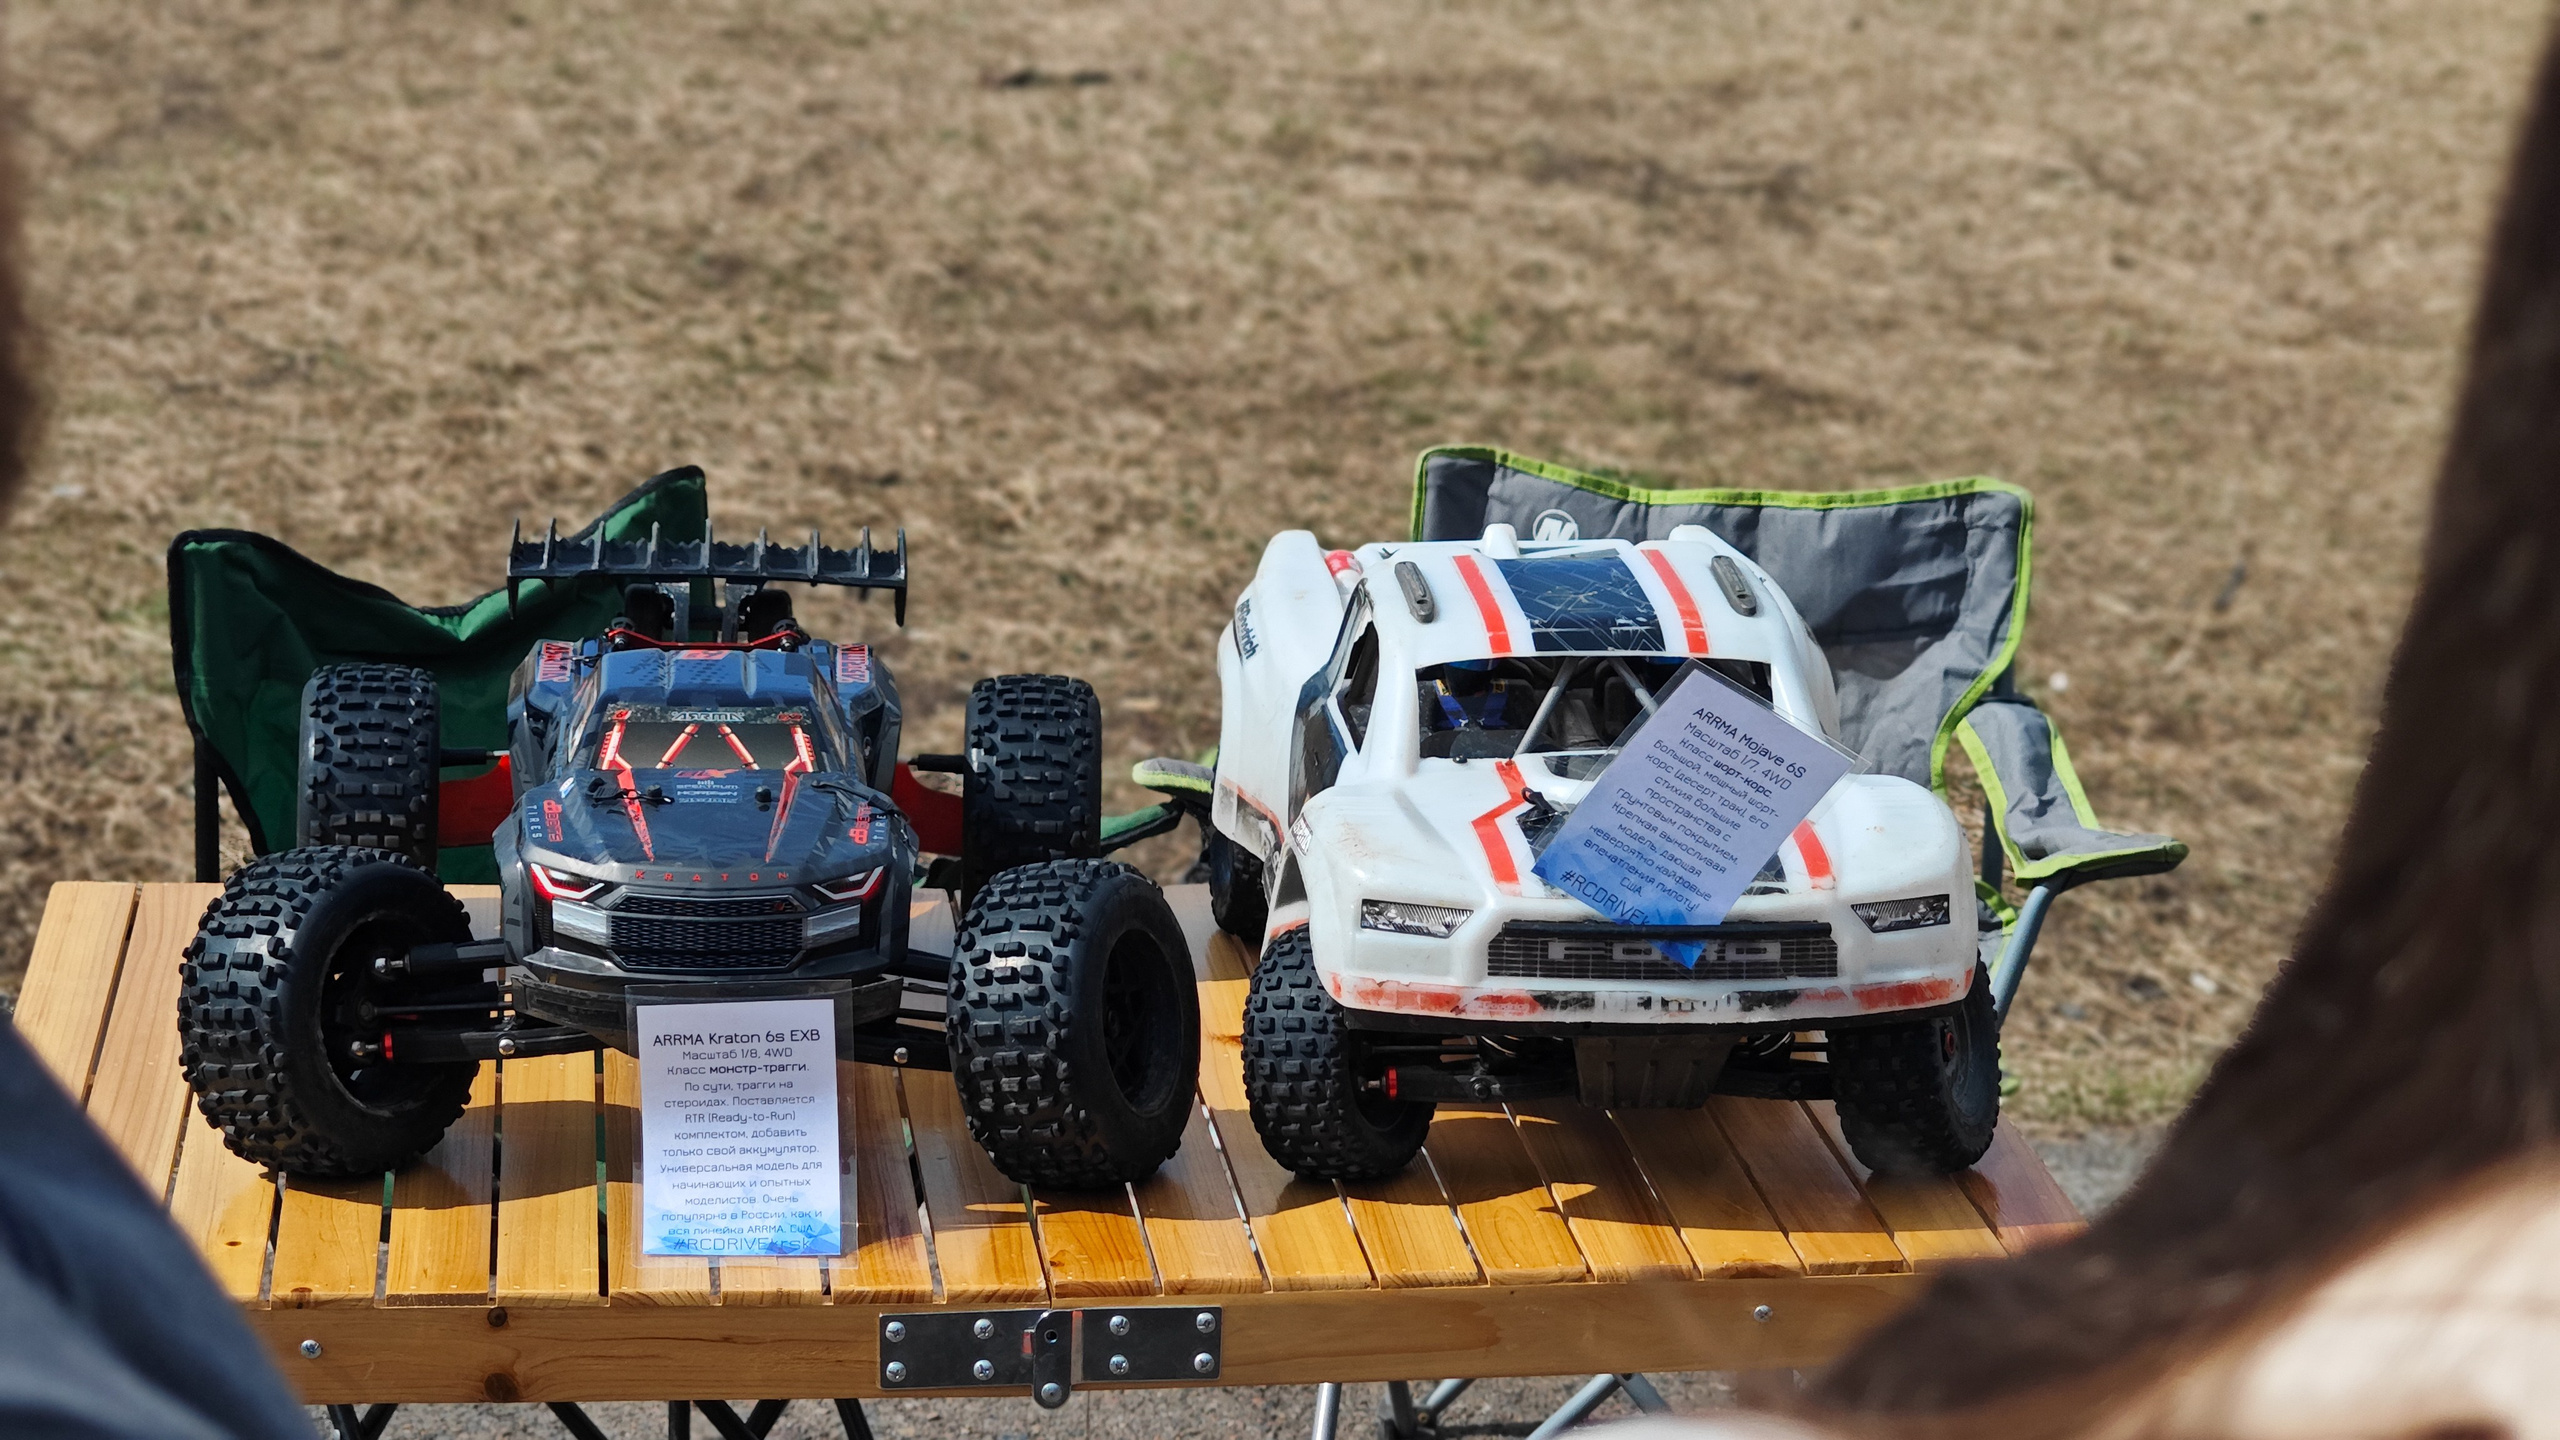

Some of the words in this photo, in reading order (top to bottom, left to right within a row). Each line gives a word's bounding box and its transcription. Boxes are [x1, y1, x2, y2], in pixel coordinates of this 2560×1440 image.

[674, 711, 744, 723] ARRMA
[1678, 737, 1714, 763] Класс
[1692, 707, 1738, 740] ARRMA
[1737, 733, 1785, 767] Mojave
[1785, 762, 1807, 779] 6S
[1683, 721, 1742, 760] Масштаб
[1761, 768, 1793, 791] 4WD
[1653, 739, 1702, 775] Большой,
[1703, 770, 1749, 800] мощный
[1747, 797, 1779, 818] шорт-
[1645, 753, 1675, 774] корс
[1748, 814, 1770, 830] его
[1616, 787, 1677, 827] грунтовым
[1654, 775, 1694, 803] стихия
[1693, 797, 1742, 831] большие
[527, 804, 543, 838] TIRES
[1644, 787, 1722, 837] пространства
[1721, 833, 1732, 843] с
[872, 812, 887, 840] TIRE
[1611, 801, 1659, 834] Крепкая
[1658, 830, 1727, 875] выносливая
[1588, 824, 1656, 867] невероятно
[1654, 864, 1713, 902] кайфовые
[1658, 849, 1703, 878] дающая
[635, 869, 789, 882] KRATON
[1583, 838, 1656, 886] впечатления
[1655, 881, 1701, 913] пилоту!
[1547, 941, 1782, 962] FOD
[652, 1033, 705, 1047] ARRMA
[708, 1032, 761, 1045] Kraton
[765, 1030, 786, 1043] 6s
[790, 1028, 821, 1042] EXB
[682, 1048, 738, 1061] Масштаб
[764, 1046, 793, 1058] 4WD
[667, 1065, 707, 1076] Класс
[709, 1063, 810, 1075] монстр-трагги.
[684, 1081, 700, 1092] По
[736, 1081, 776, 1092] трагги
[778, 1080, 794, 1089] на
[732, 1095, 816, 1106] Поставляется
[684, 1113, 706, 1124] RTR
[708, 1110, 796, 1125] (Ready-to-Run)
[750, 1127, 808, 1139] добавить
[662, 1148, 704, 1157] только
[706, 1145, 736, 1156] свой
[738, 1144, 820, 1157] аккумулятор.
[659, 1163, 753, 1175] Универсальная
[755, 1162, 799, 1172] модель
[801, 1161, 823, 1171] для
[671, 1180, 747, 1190] начинающих
[749, 1180, 757, 1188] и
[759, 1178, 812, 1188] опытных
[762, 1193, 799, 1204] Очень
[661, 1212, 728, 1224] популярна
[730, 1212, 738, 1220] в
[790, 1210, 812, 1219] как
[814, 1210, 823, 1218] и
[668, 1228, 690, 1236] вся
[693, 1226, 744, 1235] линейка
